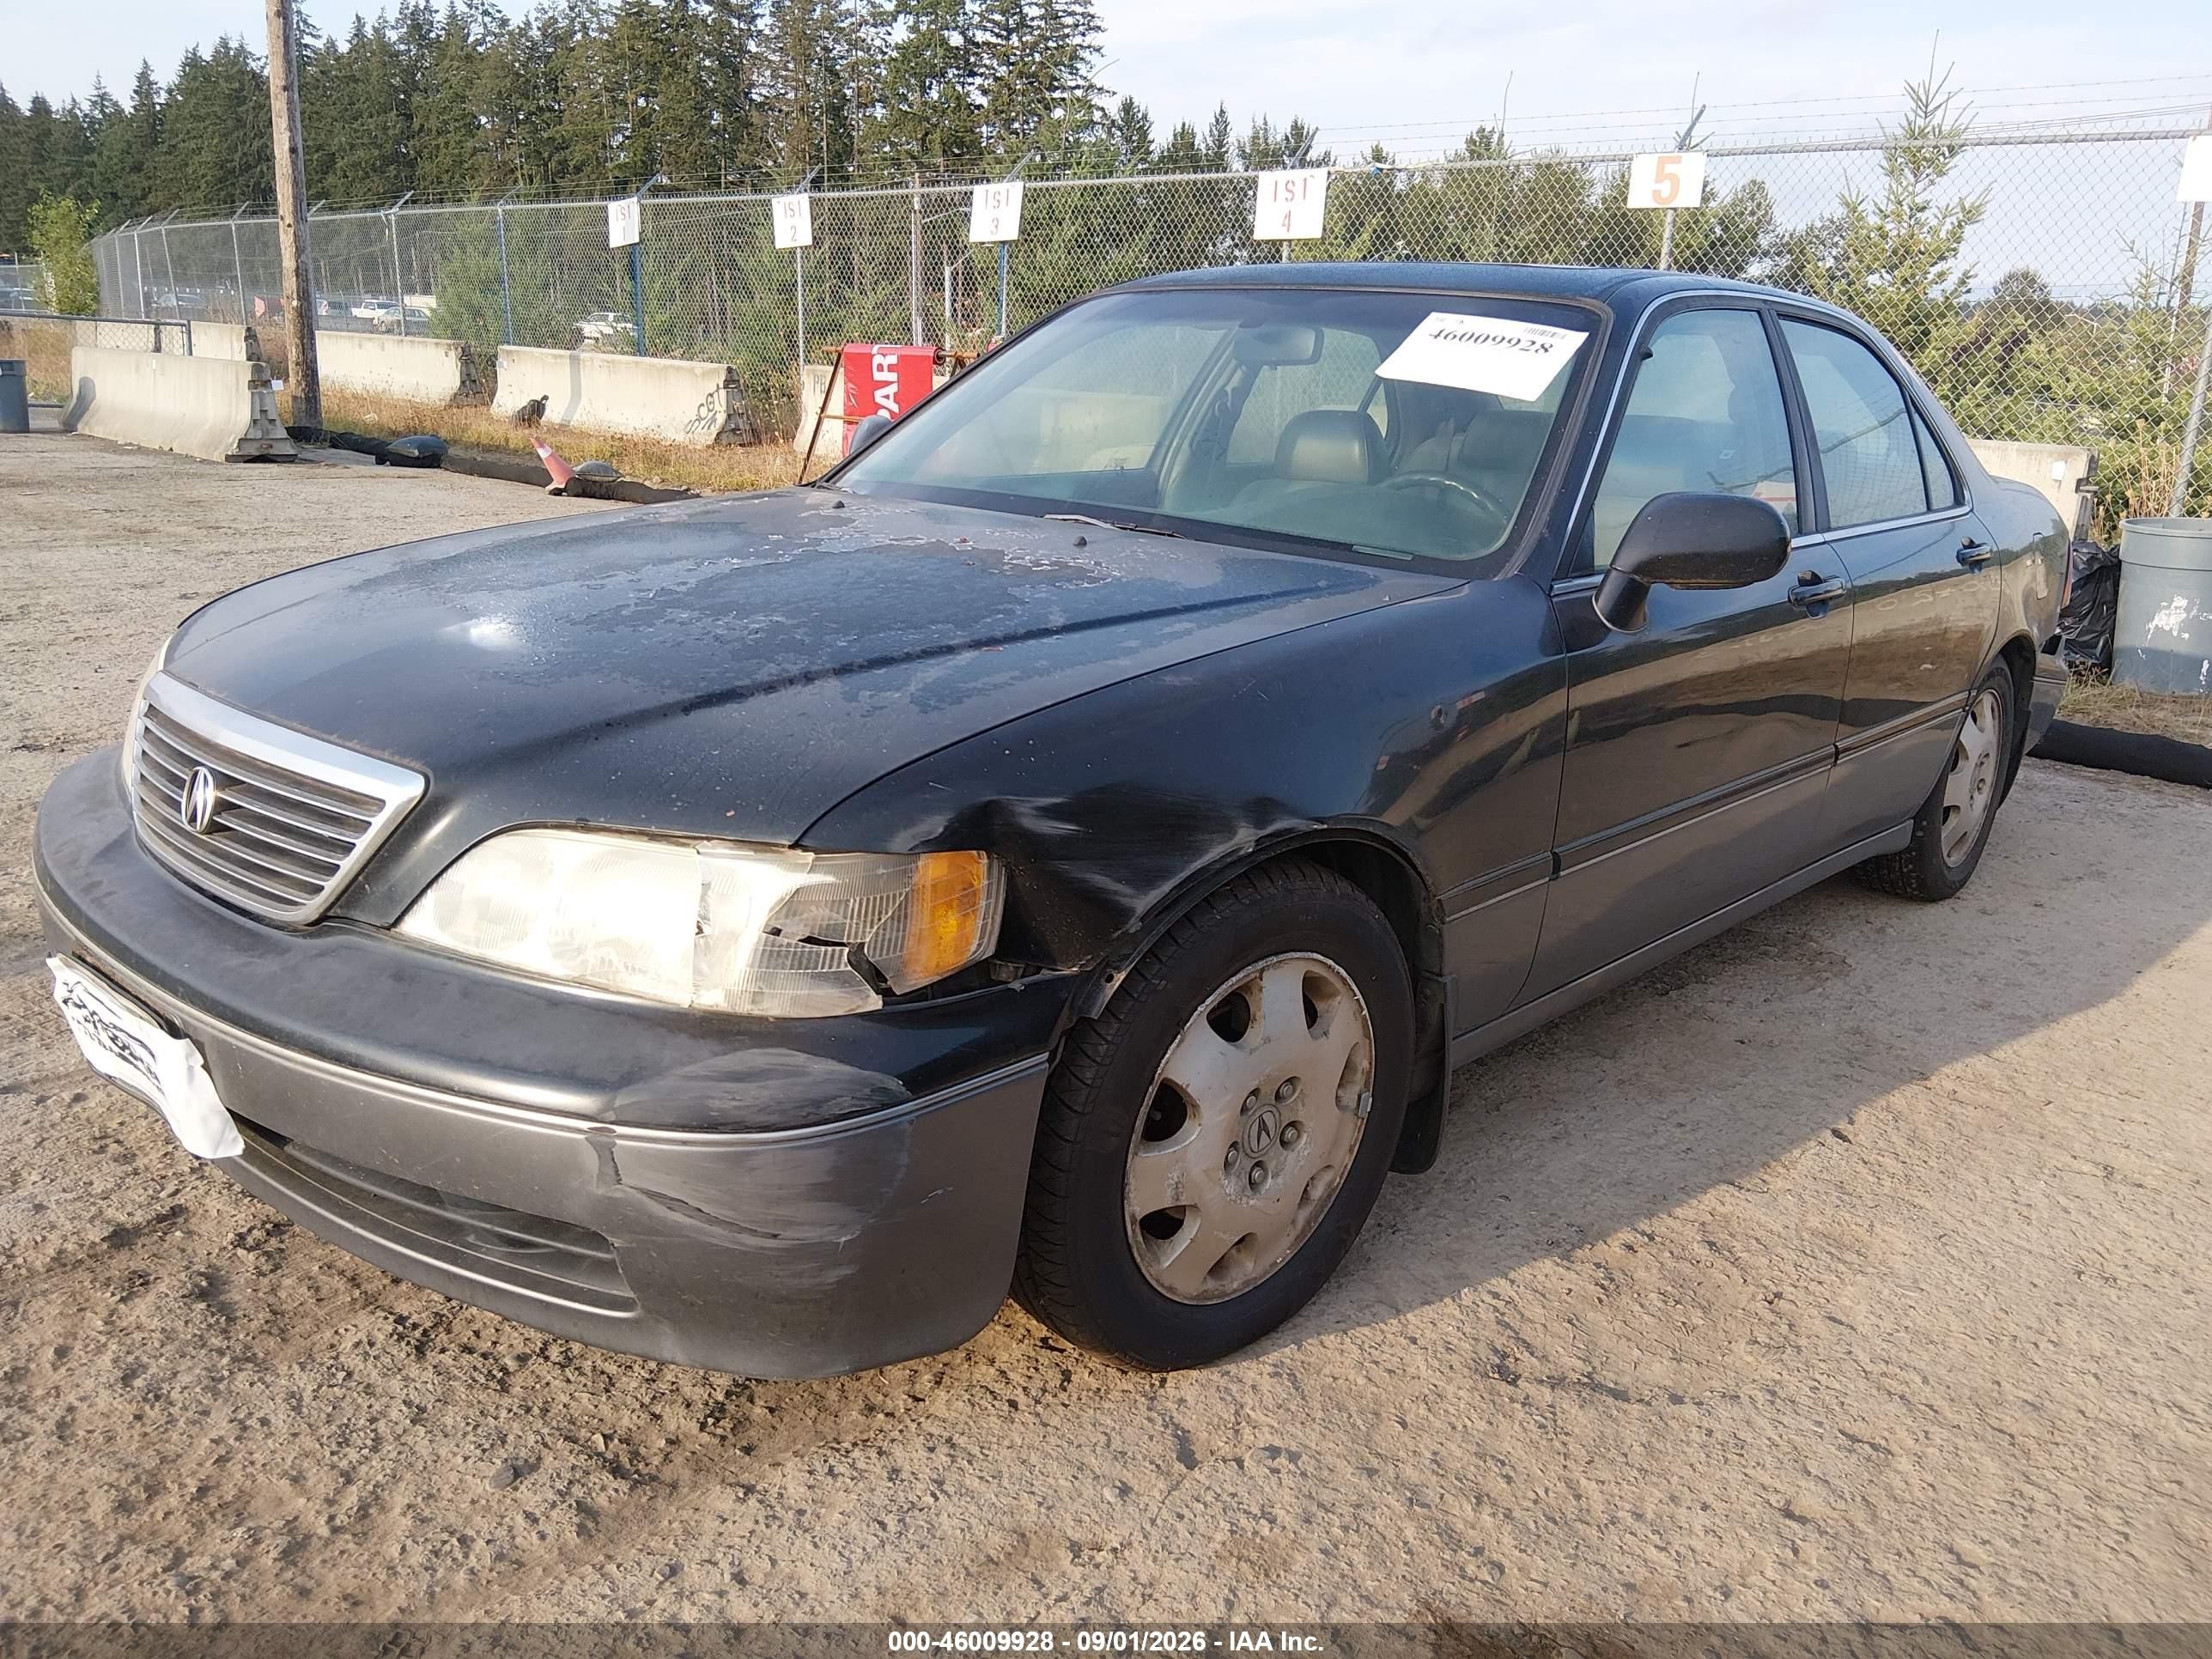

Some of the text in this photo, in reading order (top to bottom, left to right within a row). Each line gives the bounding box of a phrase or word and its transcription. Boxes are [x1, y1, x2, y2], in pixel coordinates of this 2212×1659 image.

[1652, 155, 1682, 205] 5
[790, 224, 798, 242] 2
[990, 217, 1000, 236] 3
[1280, 209, 1291, 234] 4
[1429, 328, 1553, 355] 46009928
